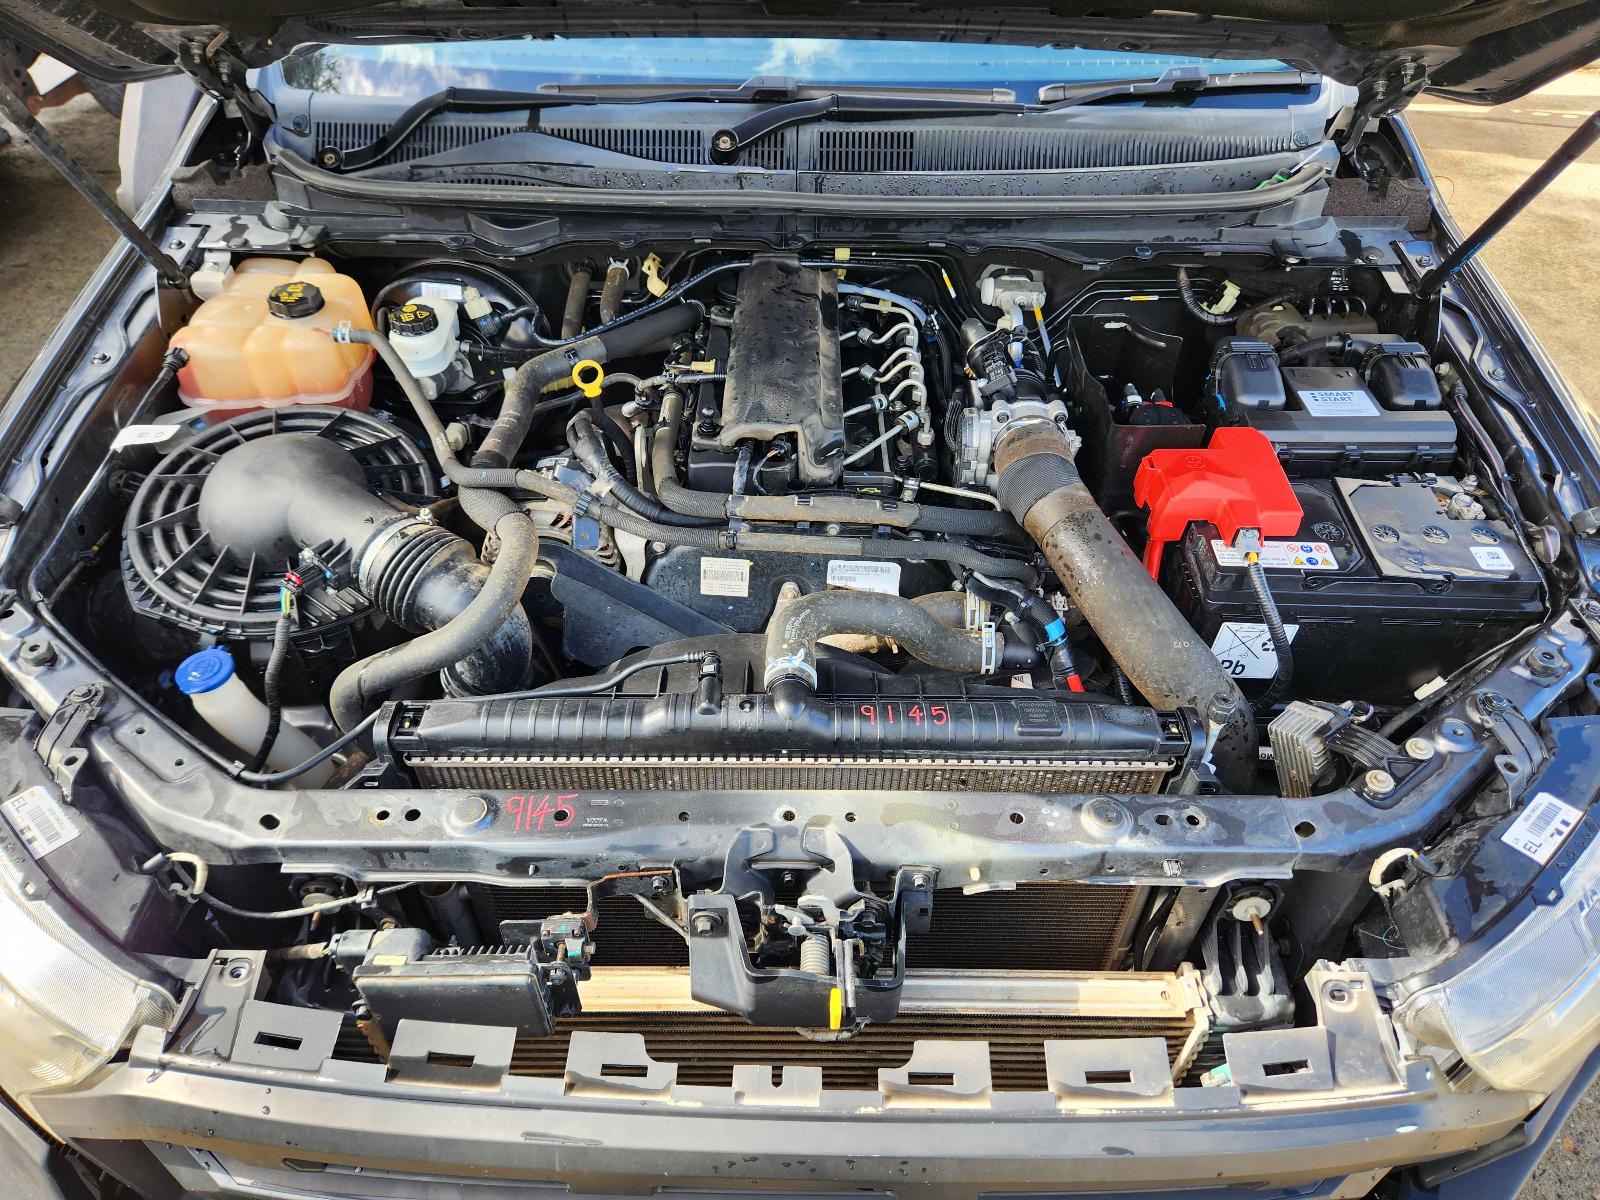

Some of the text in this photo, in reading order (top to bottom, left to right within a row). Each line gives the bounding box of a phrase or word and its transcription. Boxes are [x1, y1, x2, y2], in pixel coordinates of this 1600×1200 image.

[860, 704, 949, 726] 9145
[11, 796, 28, 814] EL
[506, 793, 579, 832] 9145
[1523, 840, 1543, 855] EL
